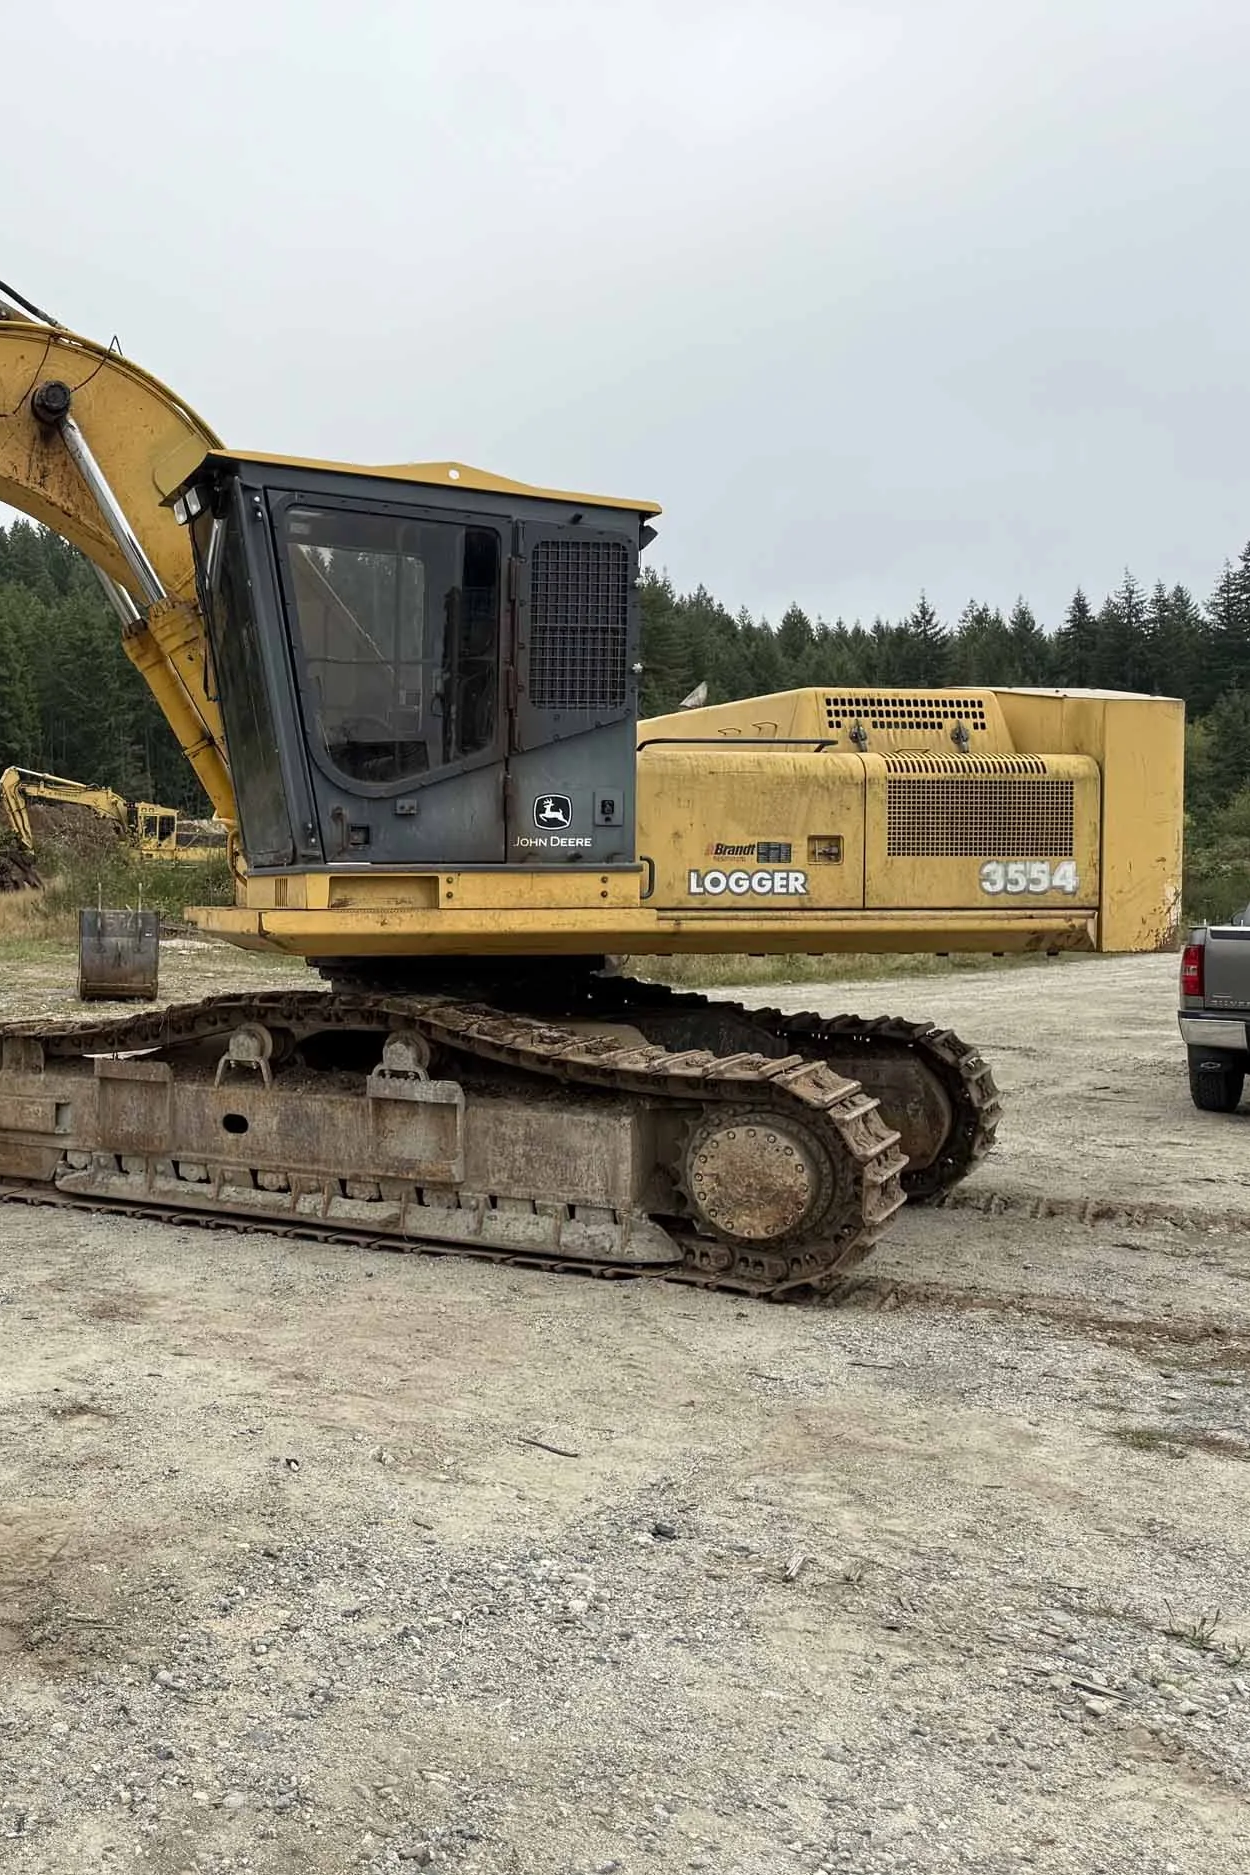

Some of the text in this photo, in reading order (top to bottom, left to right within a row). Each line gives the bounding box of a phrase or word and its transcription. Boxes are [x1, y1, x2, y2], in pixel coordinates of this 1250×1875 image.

[513, 835, 592, 847] JOHN DEERE
[713, 842, 756, 856] Brandt
[689, 871, 807, 894] LOGGER
[979, 859, 1078, 895] 3554
